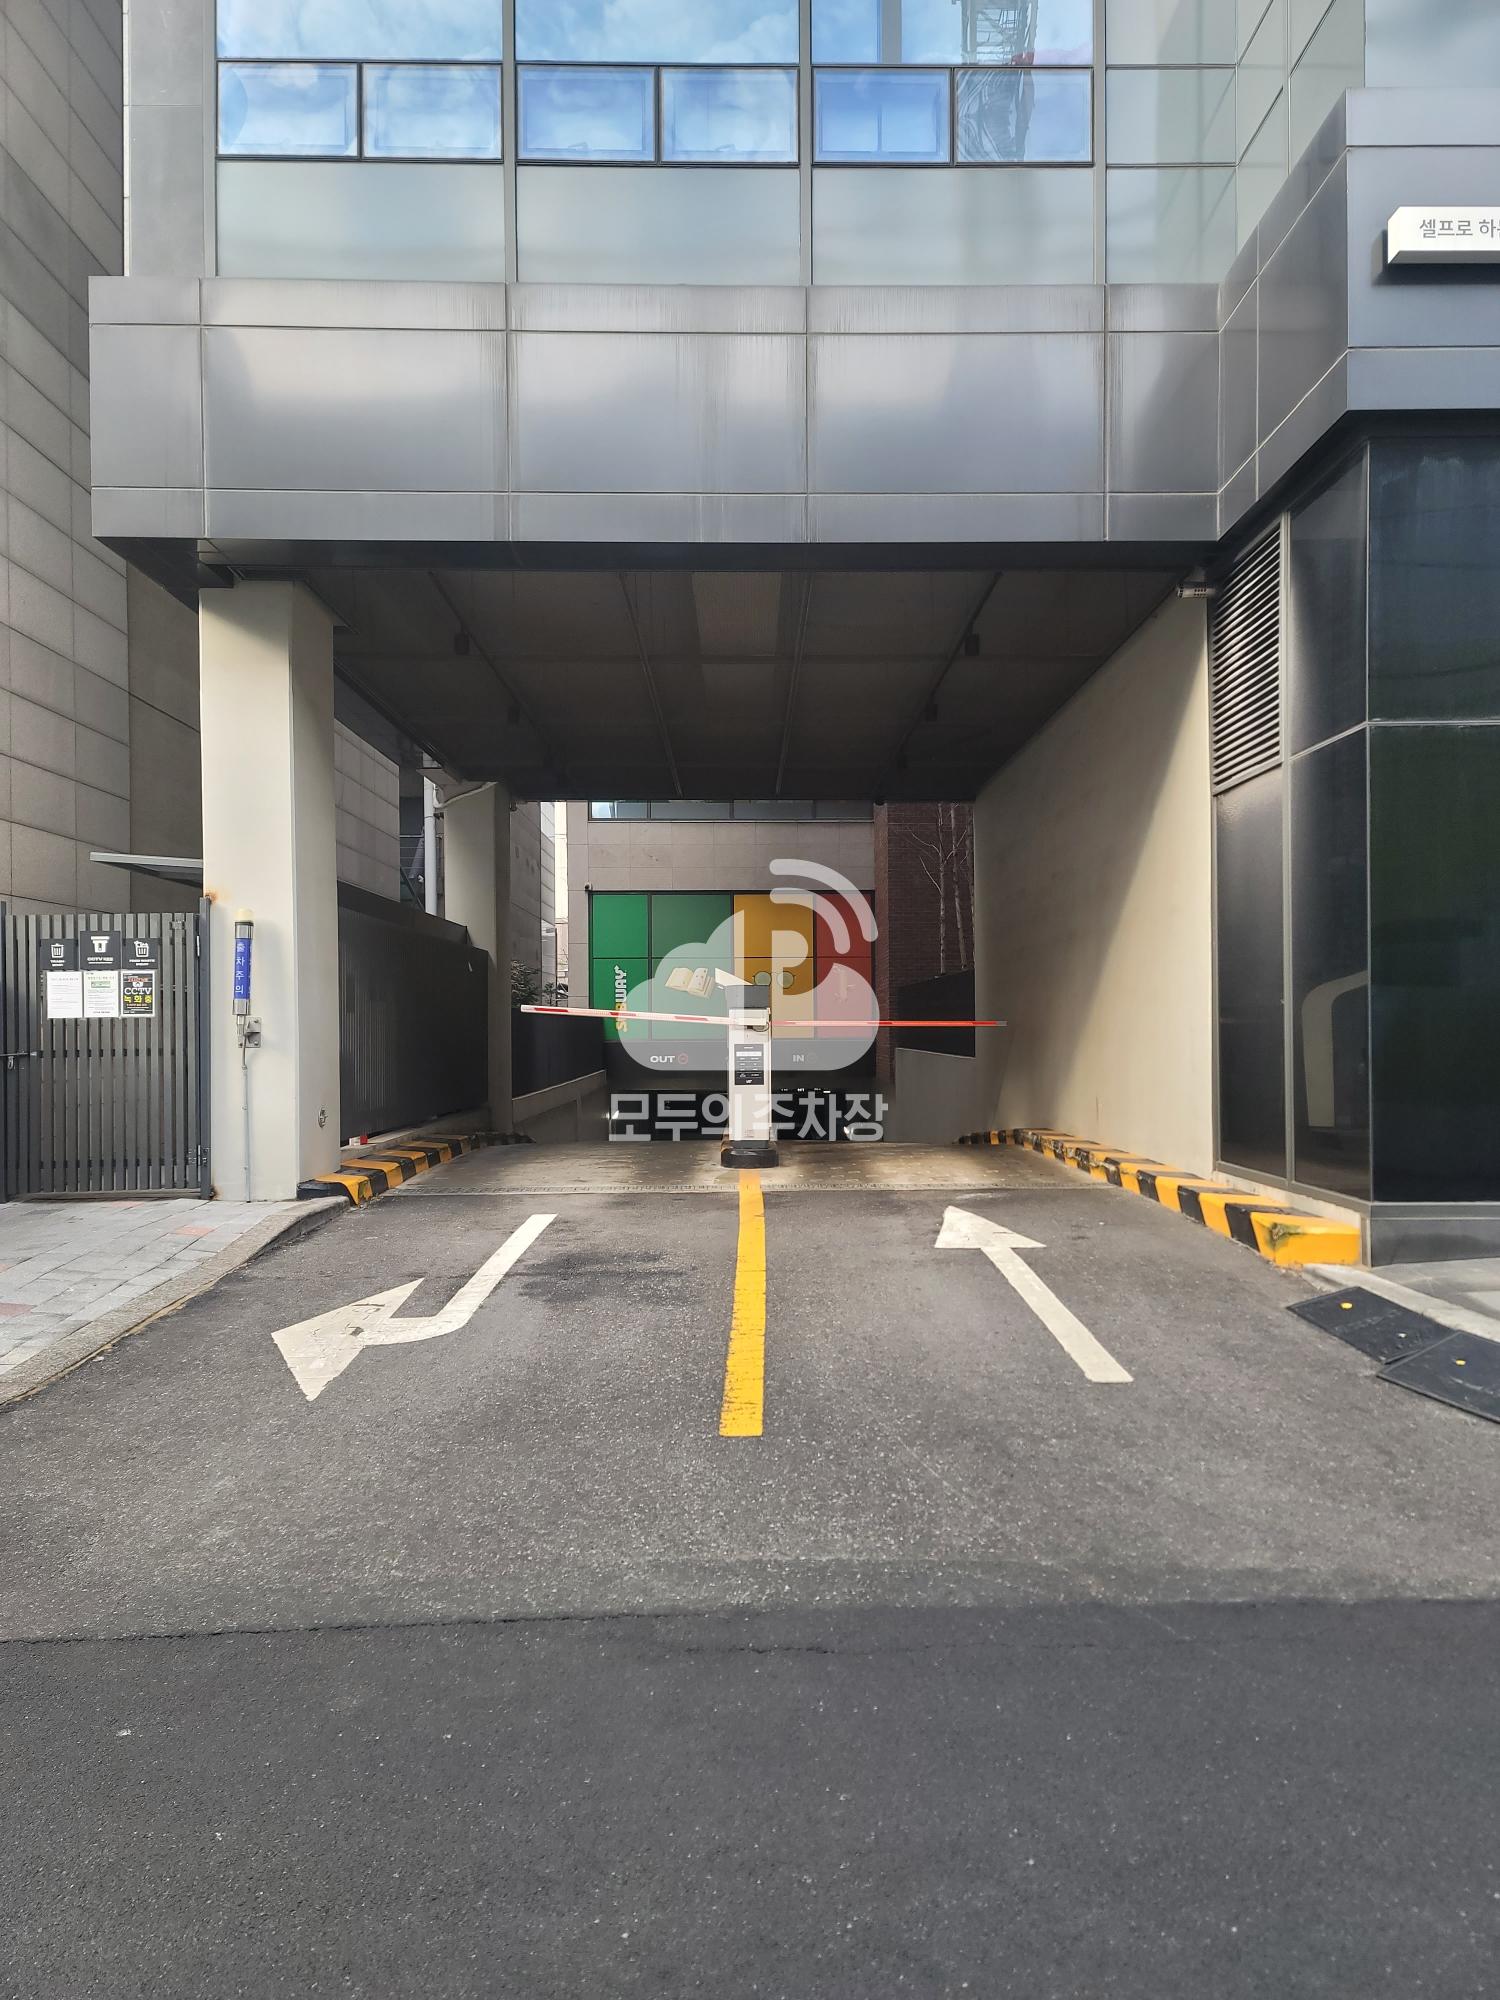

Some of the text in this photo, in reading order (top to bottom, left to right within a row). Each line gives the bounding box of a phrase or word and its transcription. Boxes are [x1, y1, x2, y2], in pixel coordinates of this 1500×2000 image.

[1419, 218, 1500, 239] 셀프로 하
[124, 987, 152, 995] CCTV
[613, 965, 628, 1033] SBWAY
[649, 1055, 676, 1063] OUT
[792, 1054, 805, 1063] IN
